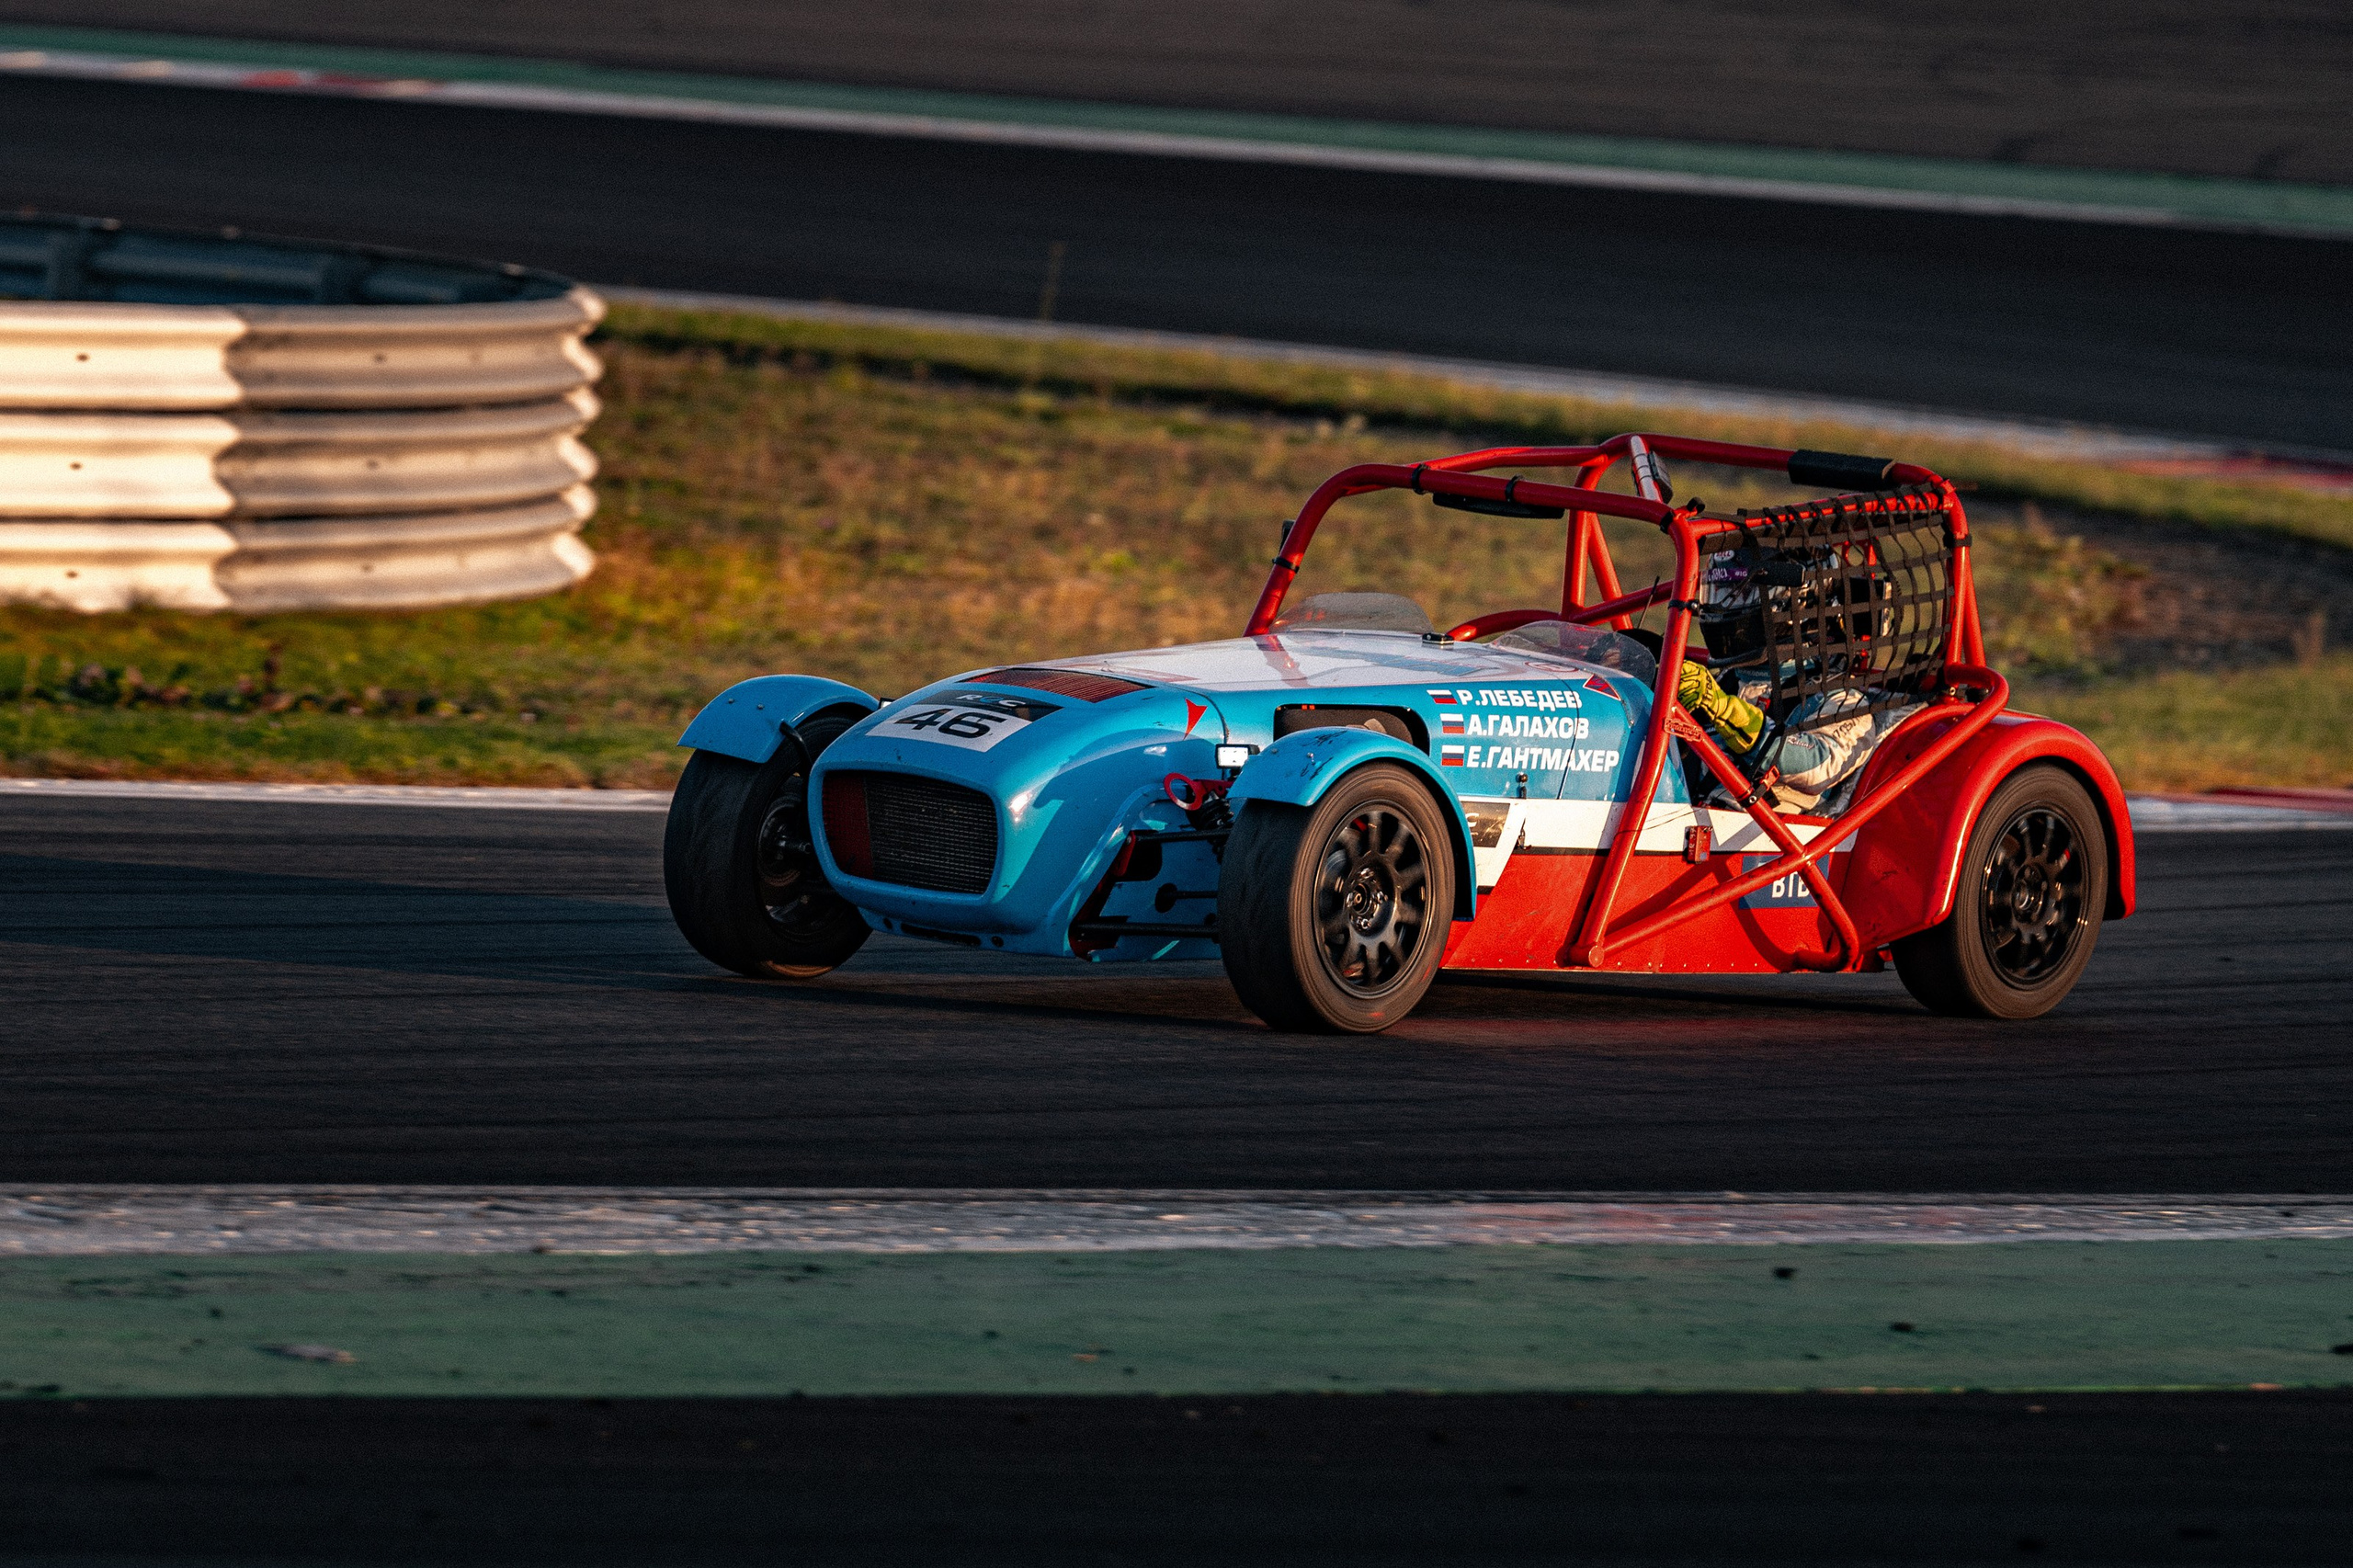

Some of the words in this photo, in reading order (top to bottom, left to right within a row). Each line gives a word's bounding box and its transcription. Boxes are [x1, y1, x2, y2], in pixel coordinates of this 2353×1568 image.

[1702, 670, 1713, 701] free
[1457, 690, 1583, 711] Р.ЛЕБЕДЕВ
[894, 708, 1007, 739] 46
[1468, 715, 1589, 739] А.ГАЛАХОВ
[1467, 746, 1620, 772] Е.ГАНТМАХЕР
